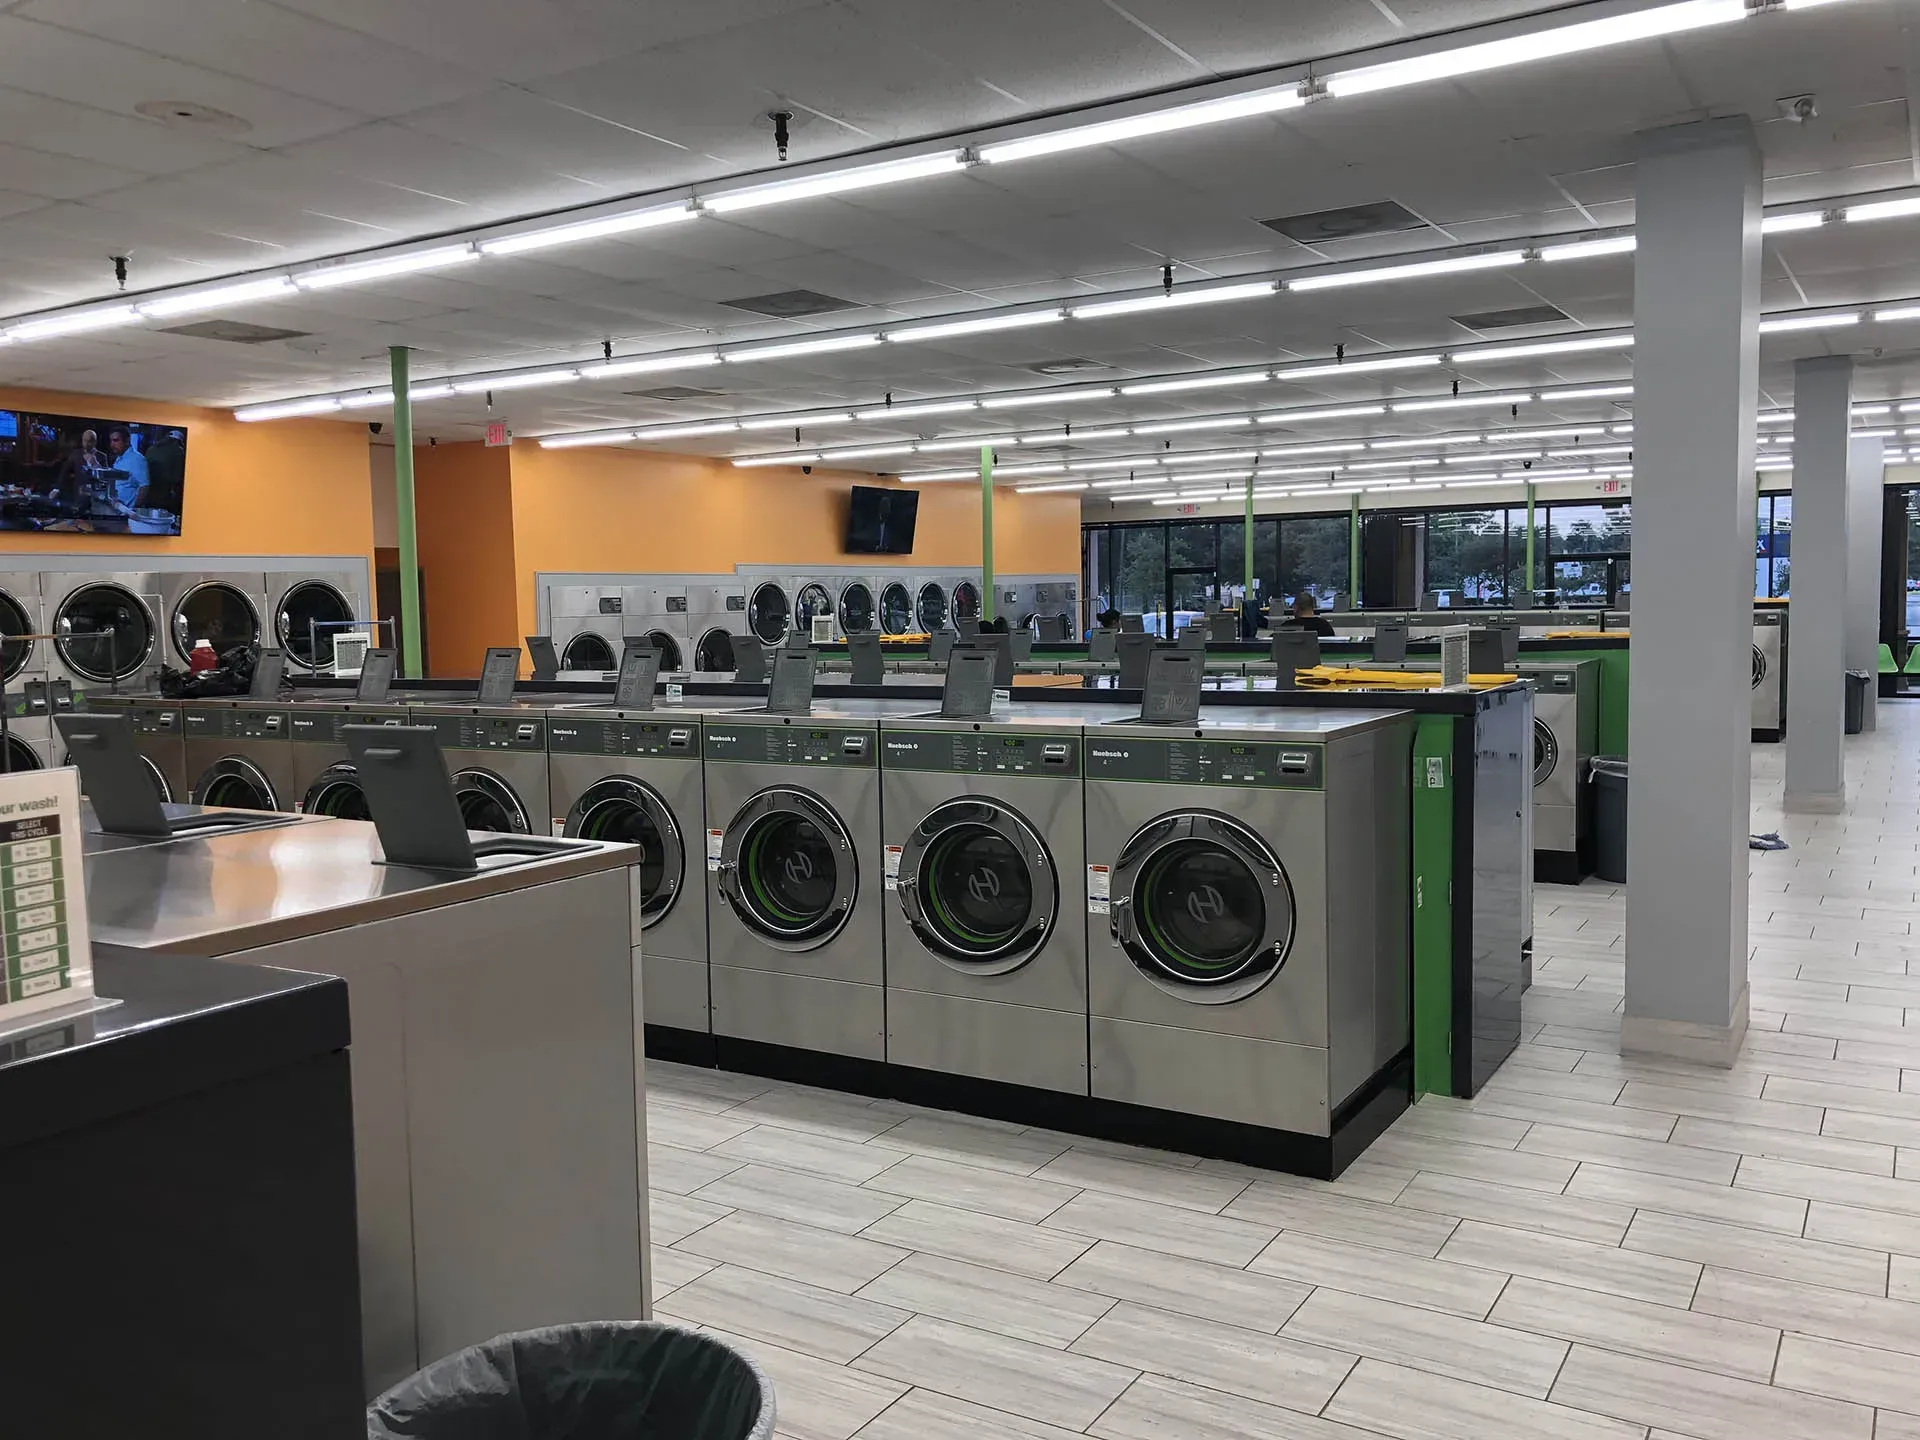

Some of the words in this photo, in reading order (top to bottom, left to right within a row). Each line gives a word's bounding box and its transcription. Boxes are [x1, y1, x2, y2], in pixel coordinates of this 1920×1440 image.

[486, 423, 505, 444] EXIT
[1603, 480, 1619, 492] EXIT
[1092, 750, 1122, 758] Huebsch
[0, 803, 15, 815] ur
[18, 796, 59, 812] wash!
[16, 819, 42, 831] SELECT
